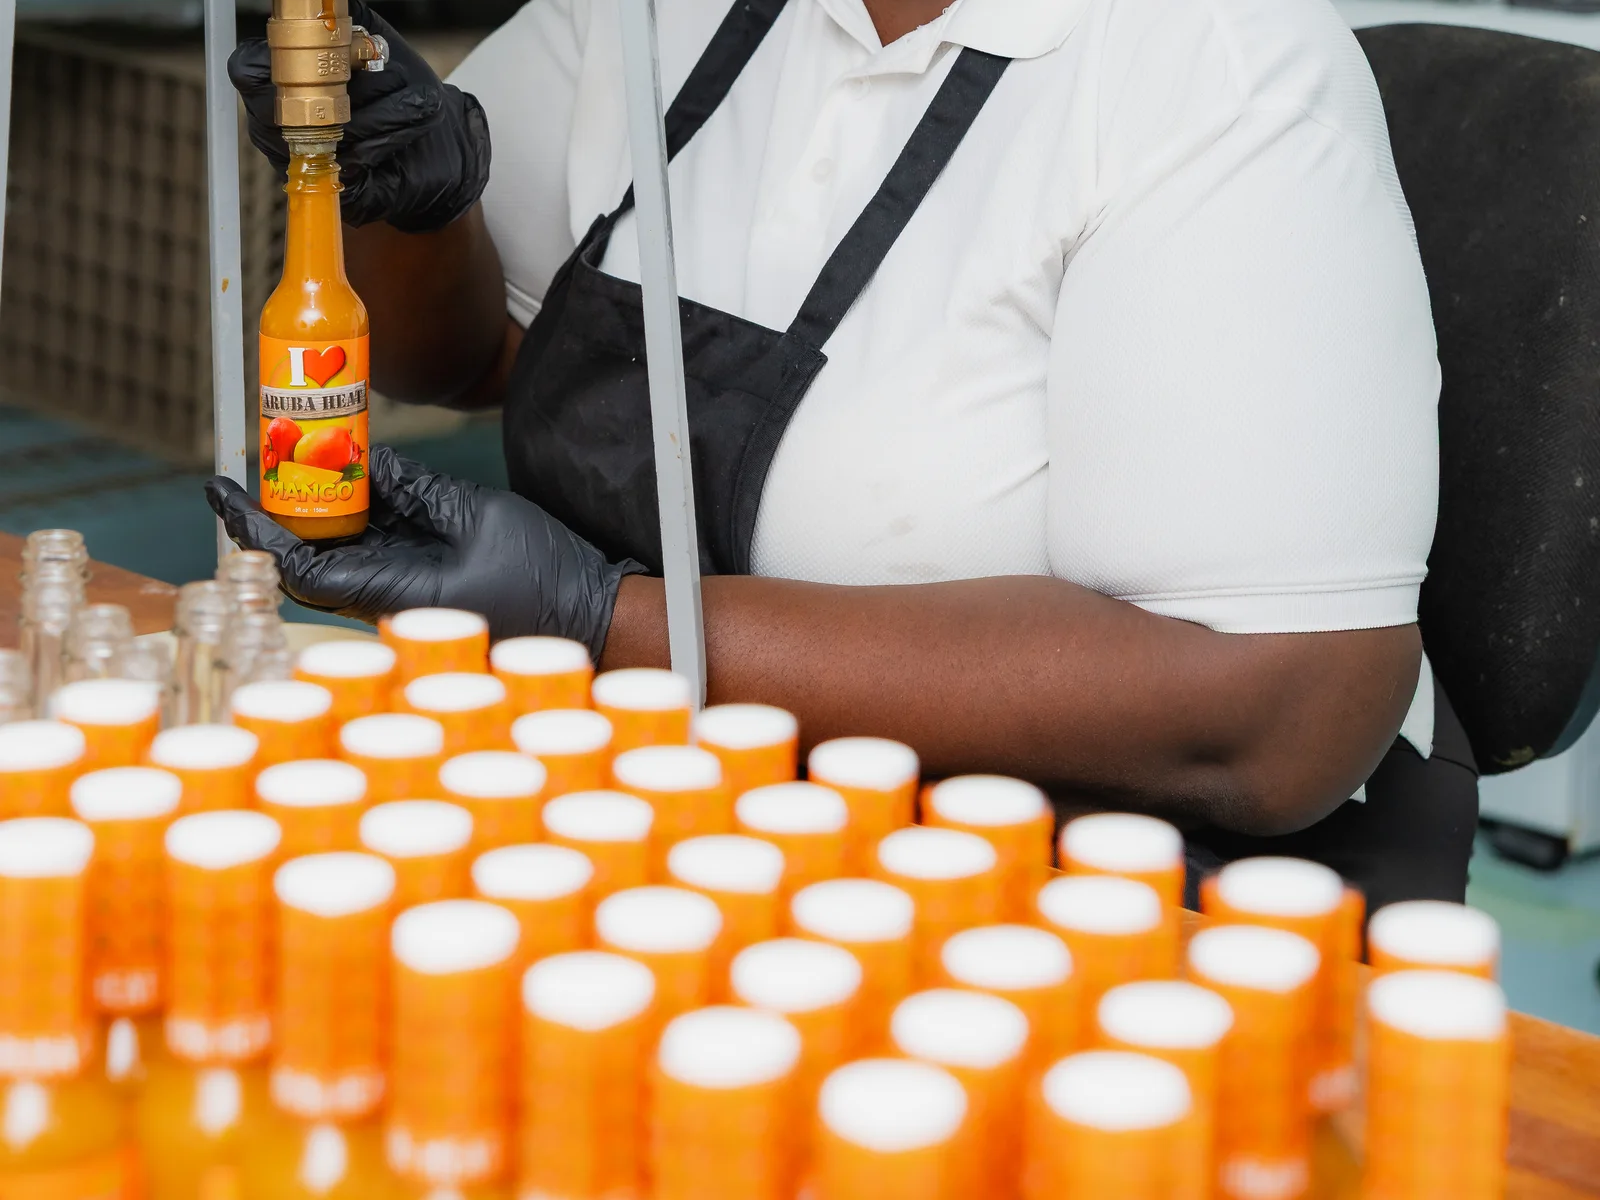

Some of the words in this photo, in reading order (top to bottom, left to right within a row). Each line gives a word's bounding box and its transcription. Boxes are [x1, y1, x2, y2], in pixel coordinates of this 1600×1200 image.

[317, 52, 328, 77] WOG
[288, 347, 307, 386] I
[263, 392, 316, 411] ARUBA
[322, 388, 364, 410] HEAT
[269, 479, 354, 502] MANGO
